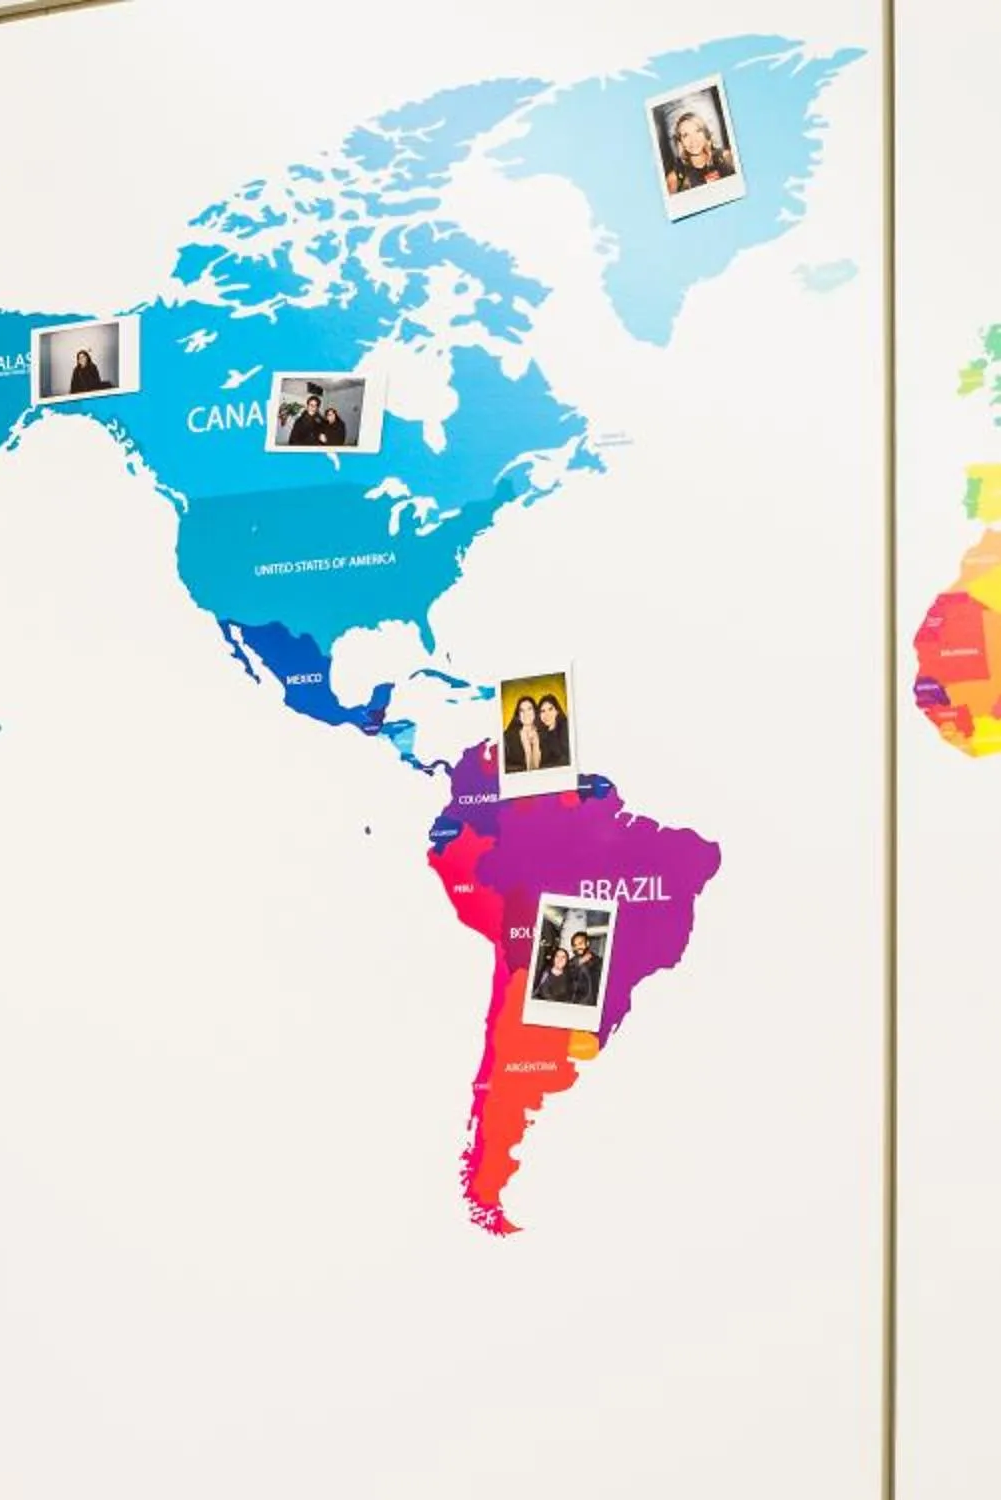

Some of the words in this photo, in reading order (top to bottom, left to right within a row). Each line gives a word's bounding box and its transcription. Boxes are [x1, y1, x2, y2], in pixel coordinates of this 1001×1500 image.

[187, 401, 264, 433] CANA
[254, 562, 294, 577] UNITED
[294, 558, 330, 573] STATES
[332, 557, 345, 569] OF
[348, 552, 396, 568] AMERICA
[286, 673, 322, 685] MEXICO
[580, 876, 672, 902] BRAZIL
[504, 1061, 558, 1073] ARGENTINA
